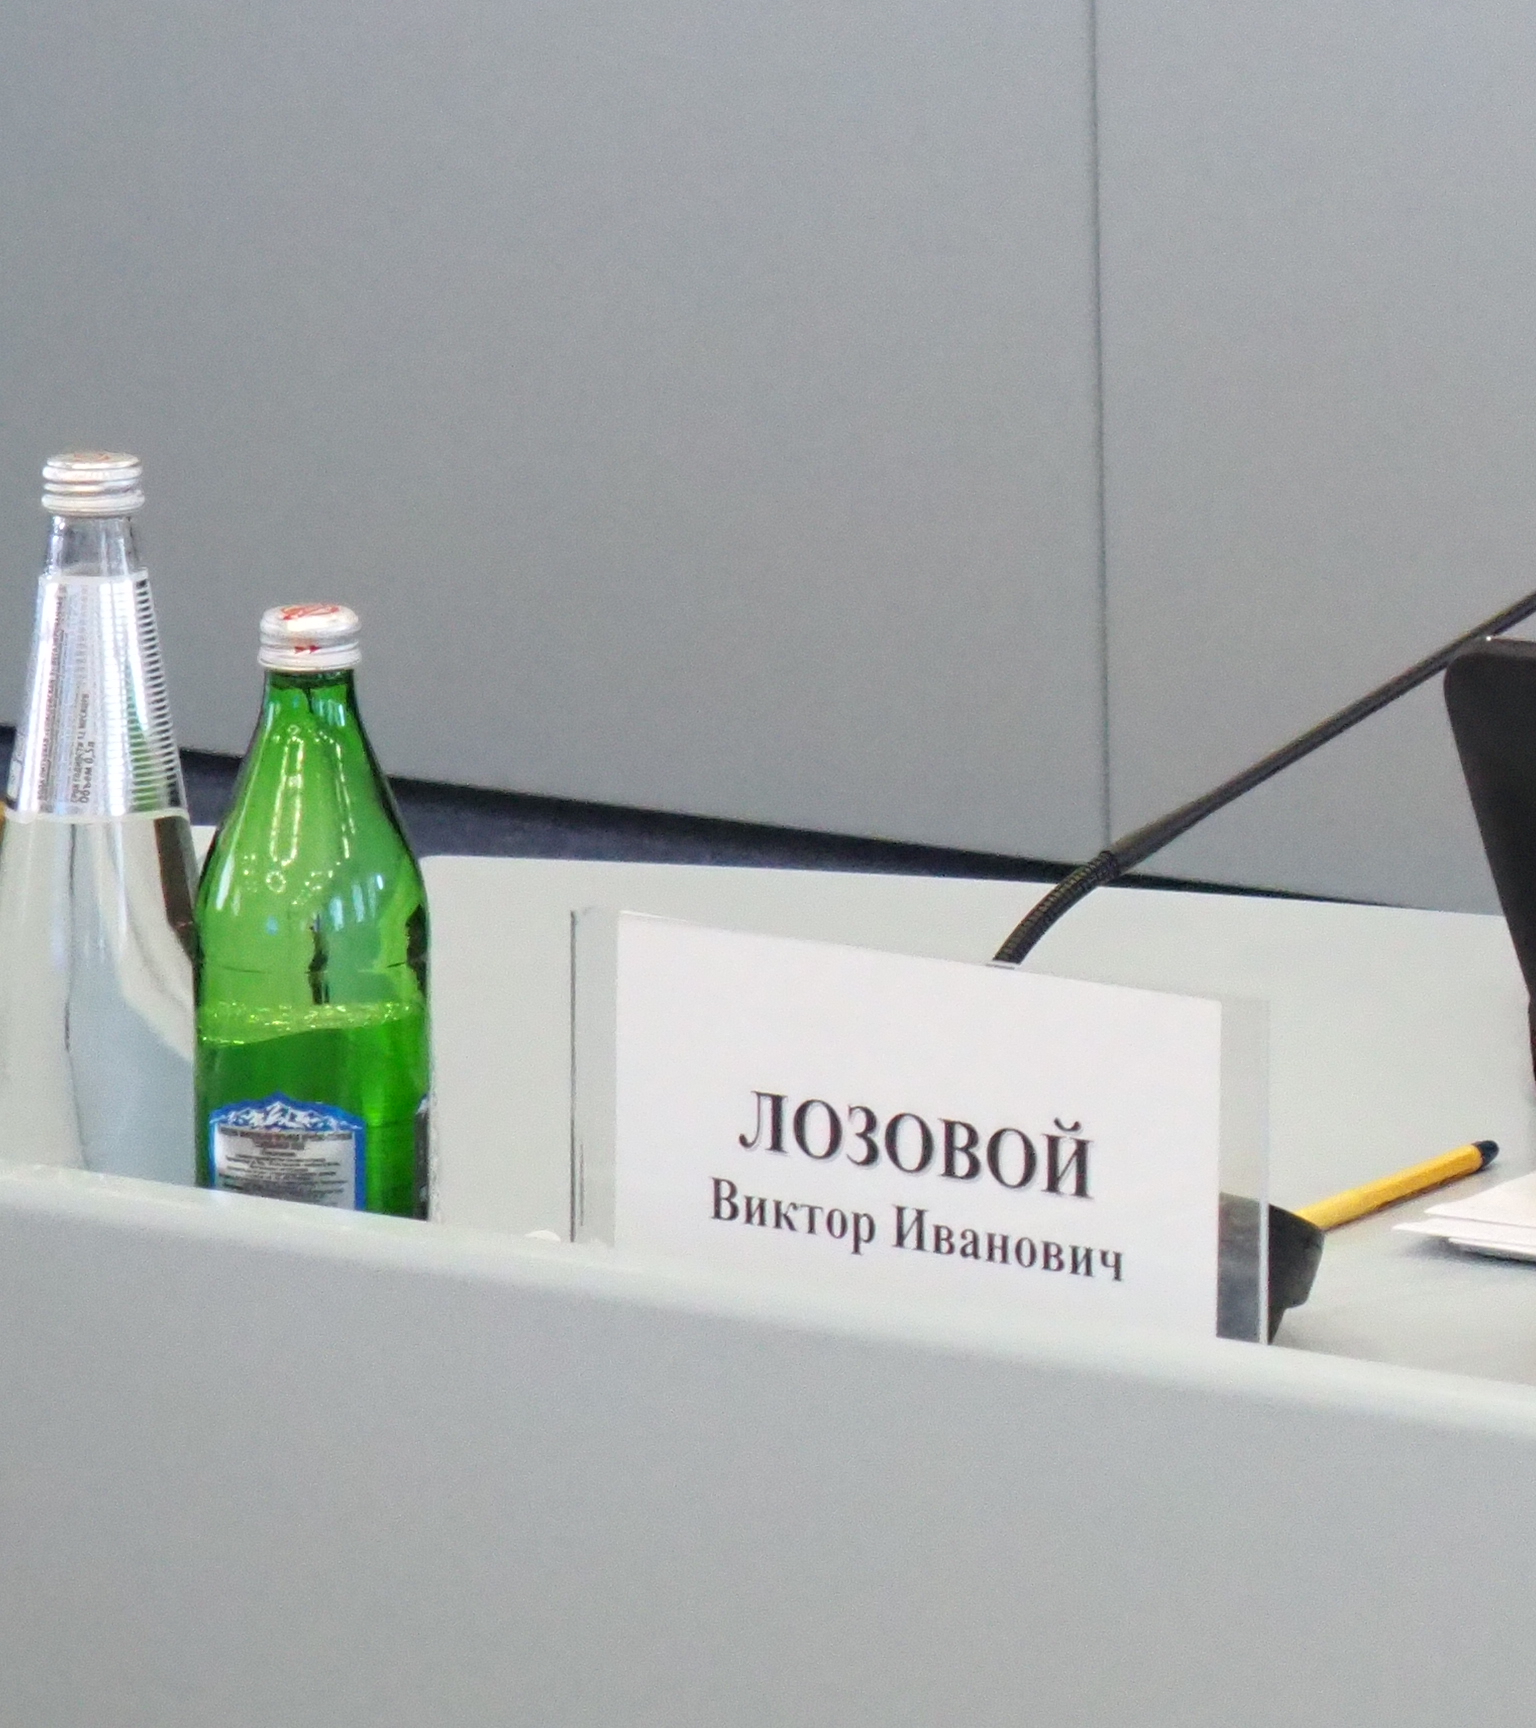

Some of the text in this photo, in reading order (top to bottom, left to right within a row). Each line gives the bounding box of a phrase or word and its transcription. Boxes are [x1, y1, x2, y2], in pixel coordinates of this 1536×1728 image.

[79, 767, 92, 804] Объем
[738, 1090, 1094, 1200] ЛОЗОВОЙ
[711, 1176, 1126, 1283] Виктор Иванович
